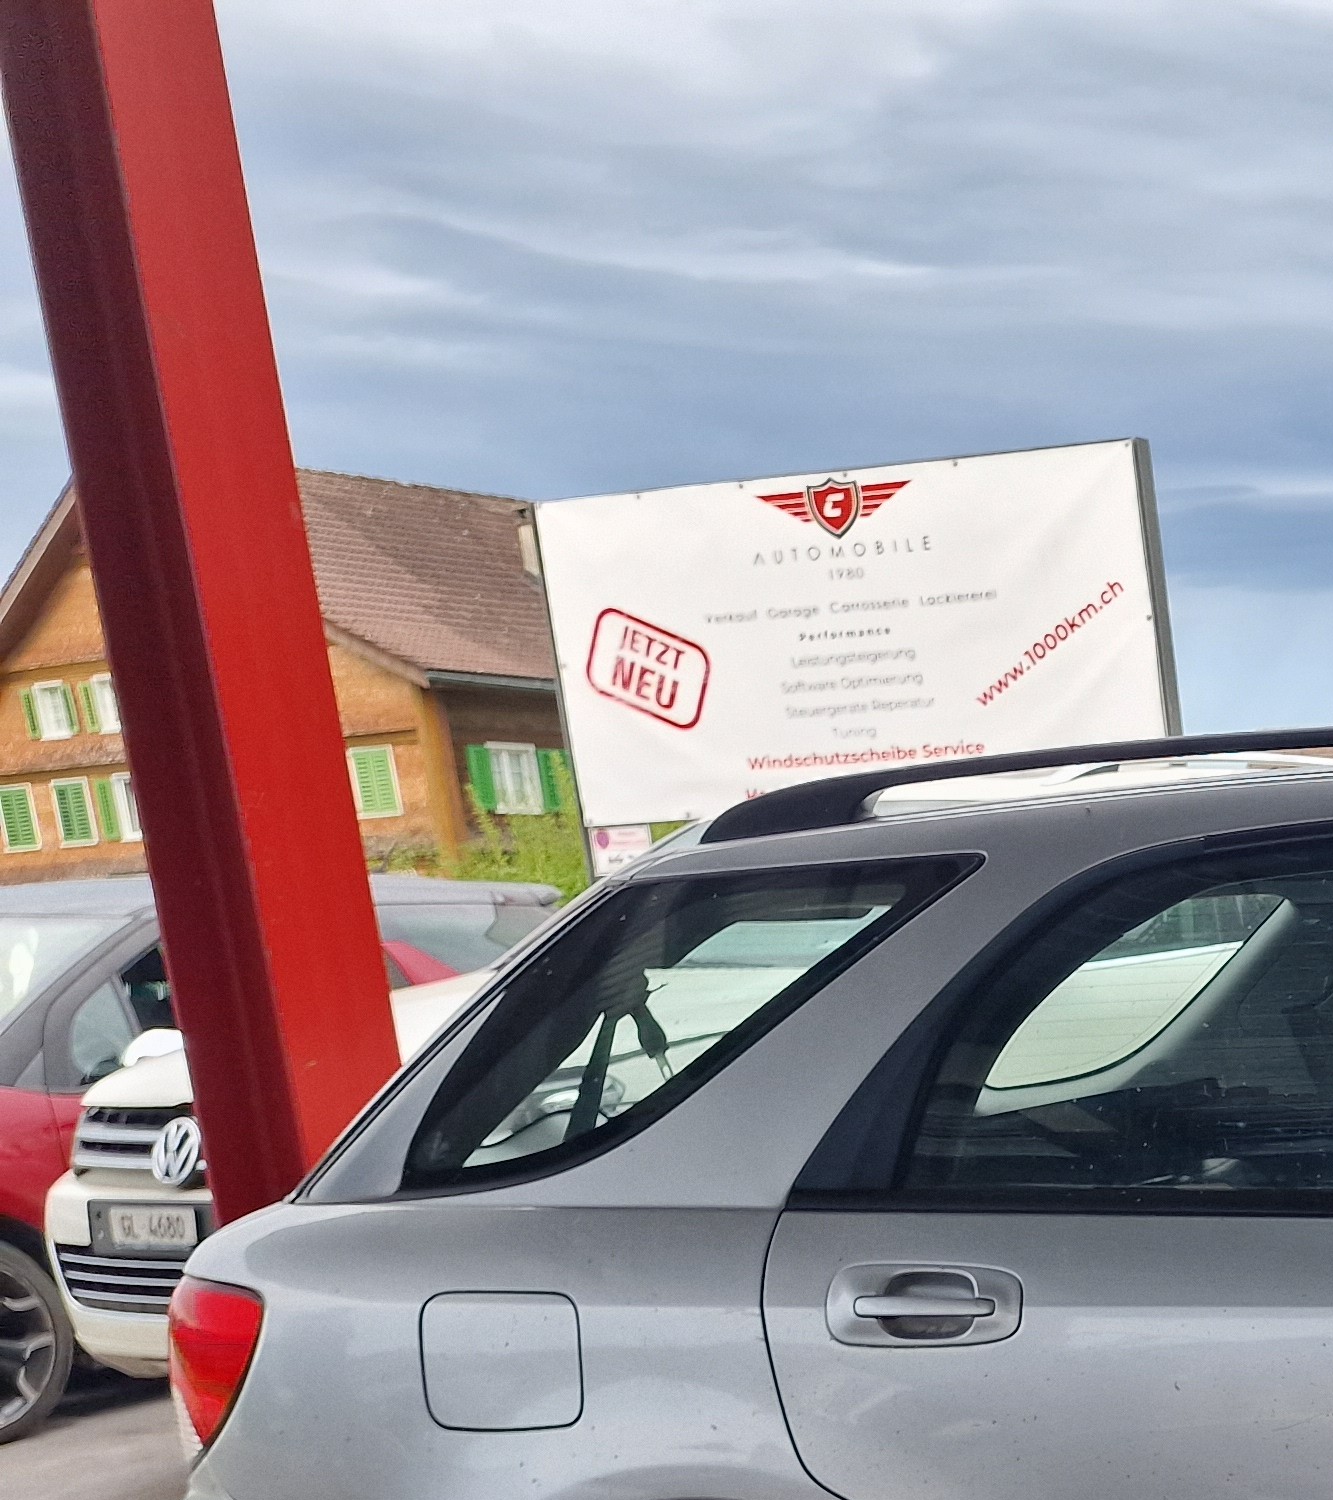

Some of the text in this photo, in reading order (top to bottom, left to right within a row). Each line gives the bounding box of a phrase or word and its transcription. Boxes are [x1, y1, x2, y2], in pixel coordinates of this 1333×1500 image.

[753, 535, 932, 566] AUTOMOBILE
[620, 625, 686, 670] JETZT
[799, 627, 891, 641] Performance
[977, 581, 1125, 706] www.1000km.ch
[612, 656, 679, 709] NEU
[749, 741, 985, 770] Windschutzscheibe Service
